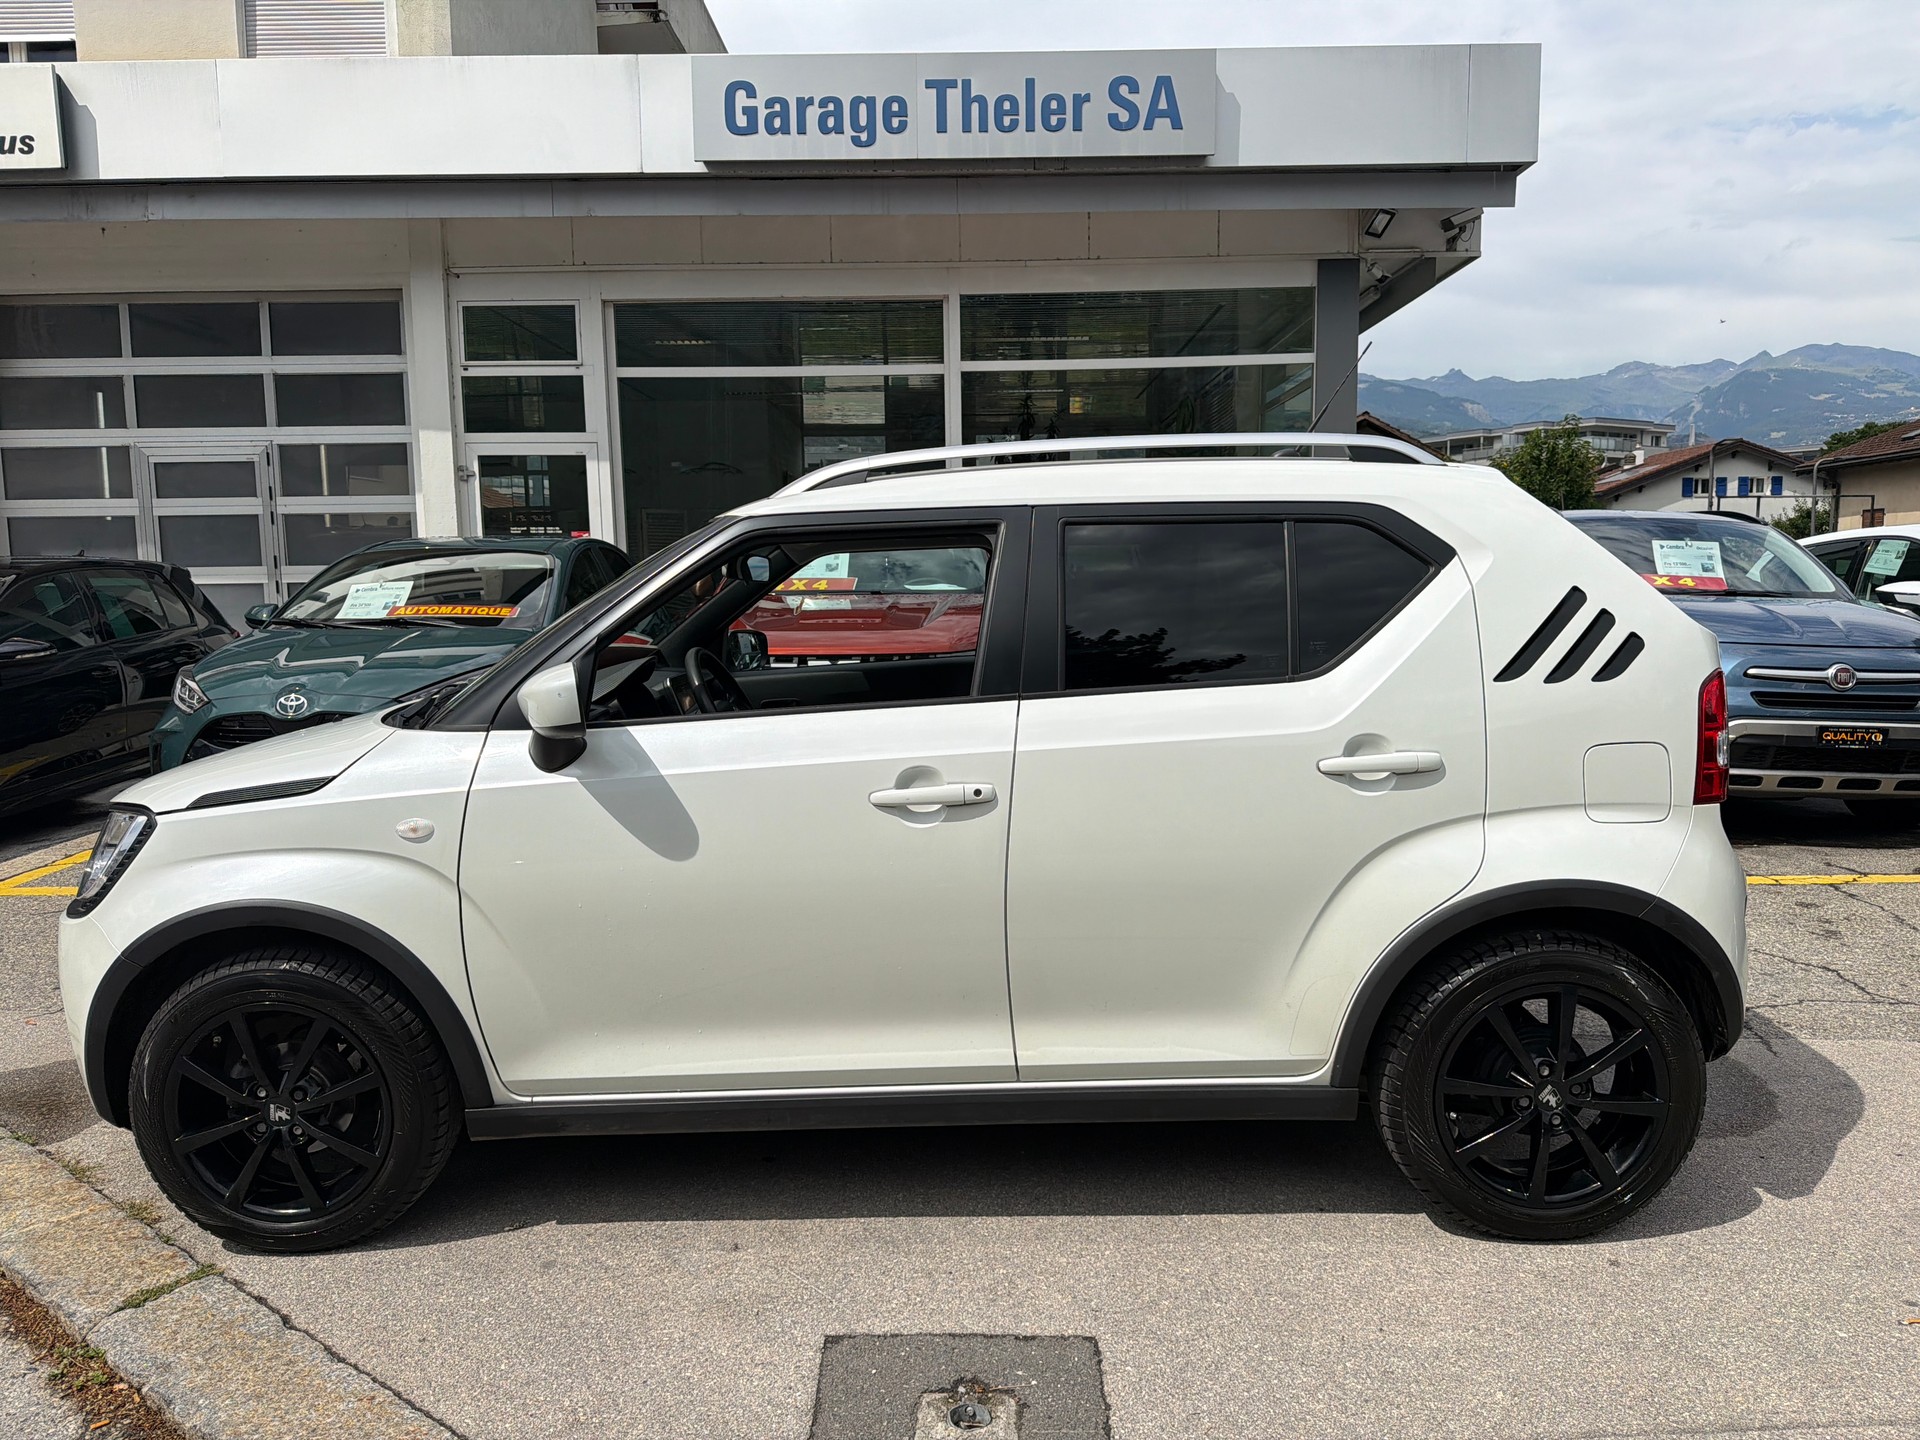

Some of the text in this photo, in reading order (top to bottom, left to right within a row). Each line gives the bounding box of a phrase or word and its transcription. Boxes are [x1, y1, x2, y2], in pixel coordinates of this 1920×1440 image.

[723, 75, 1184, 147] Garage Theler SA
[0, 134, 35, 155] us
[394, 606, 512, 616] AUTOMATIQUE
[1837, 672, 1850, 683] FIAT
[1822, 732, 1871, 740] QUALITY
